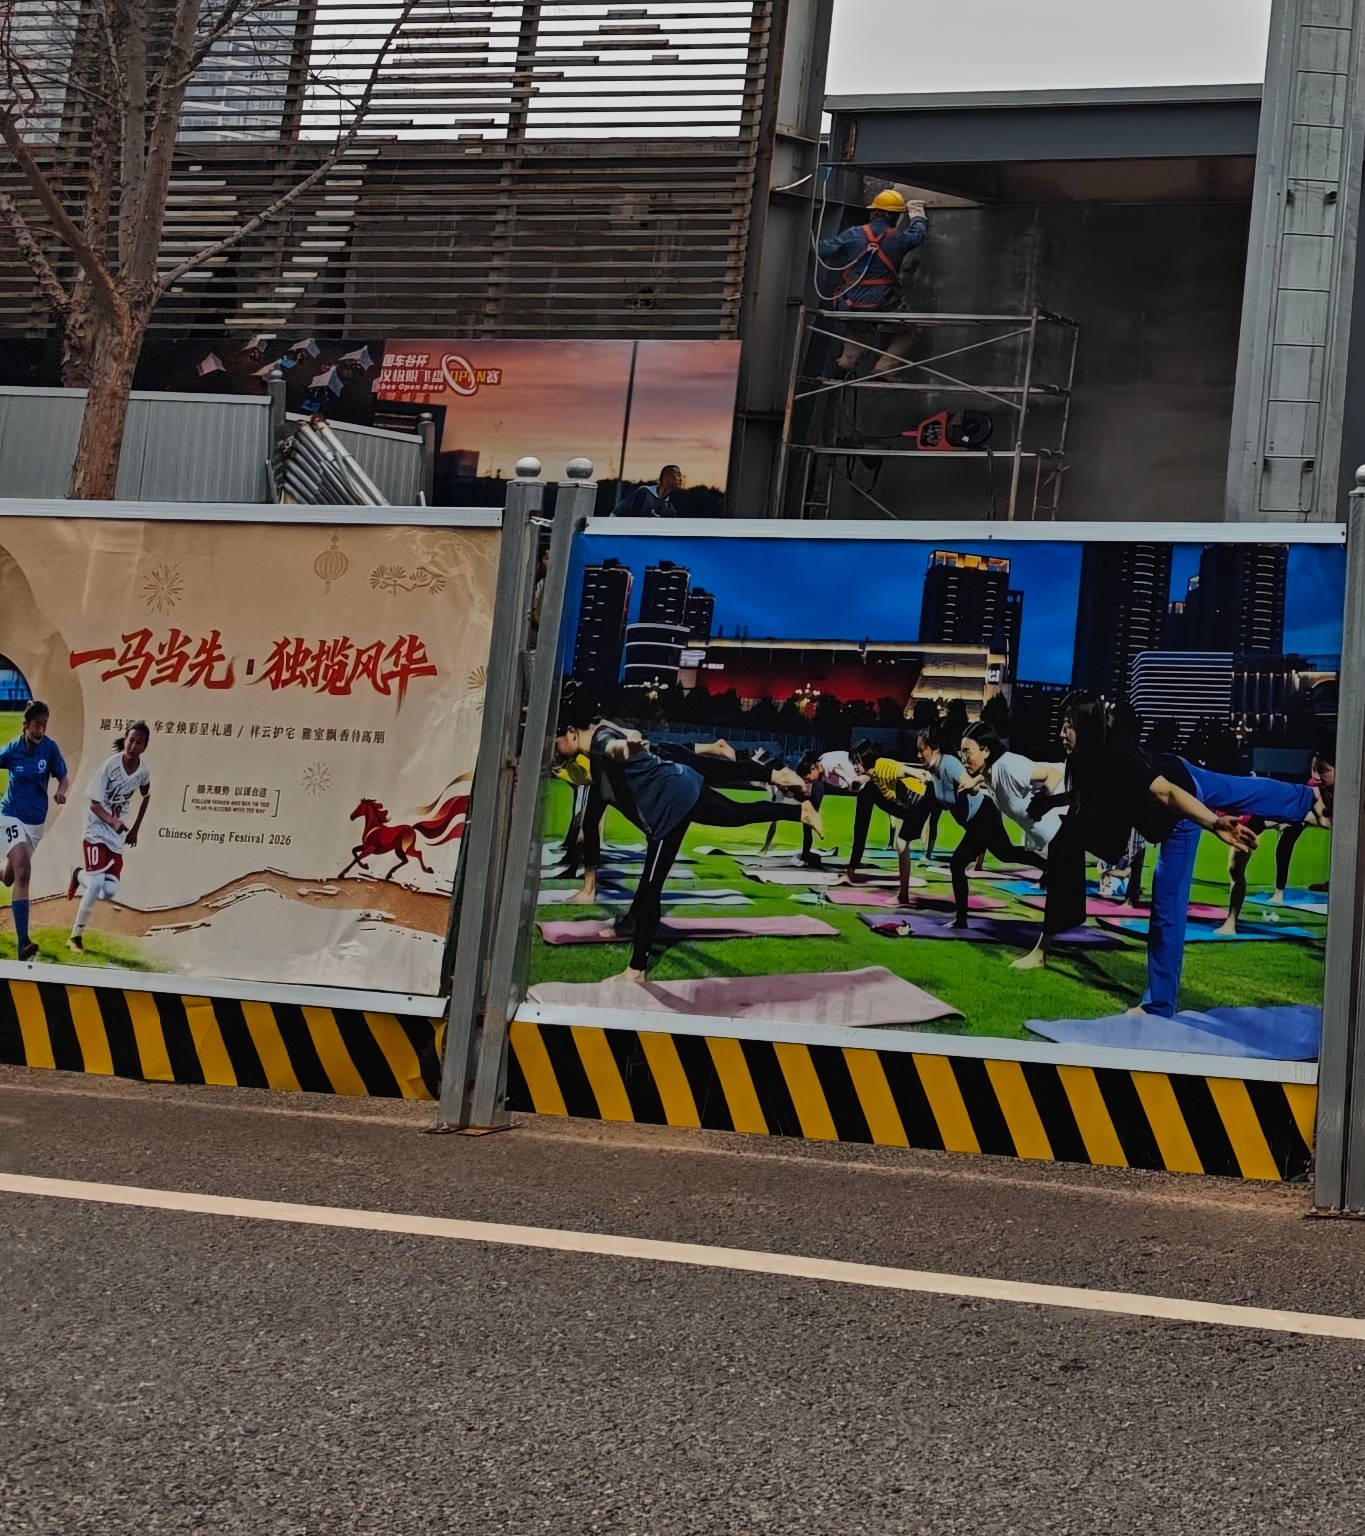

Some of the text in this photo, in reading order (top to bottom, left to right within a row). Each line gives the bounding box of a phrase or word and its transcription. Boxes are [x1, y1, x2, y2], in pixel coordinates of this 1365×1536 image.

[70, 627, 438, 714] 一马当先 独揽风华
[5, 825, 19, 843] 35
[158, 827, 292, 845] Chinese Spring Festival 2026
[87, 846, 99, 866] 10
